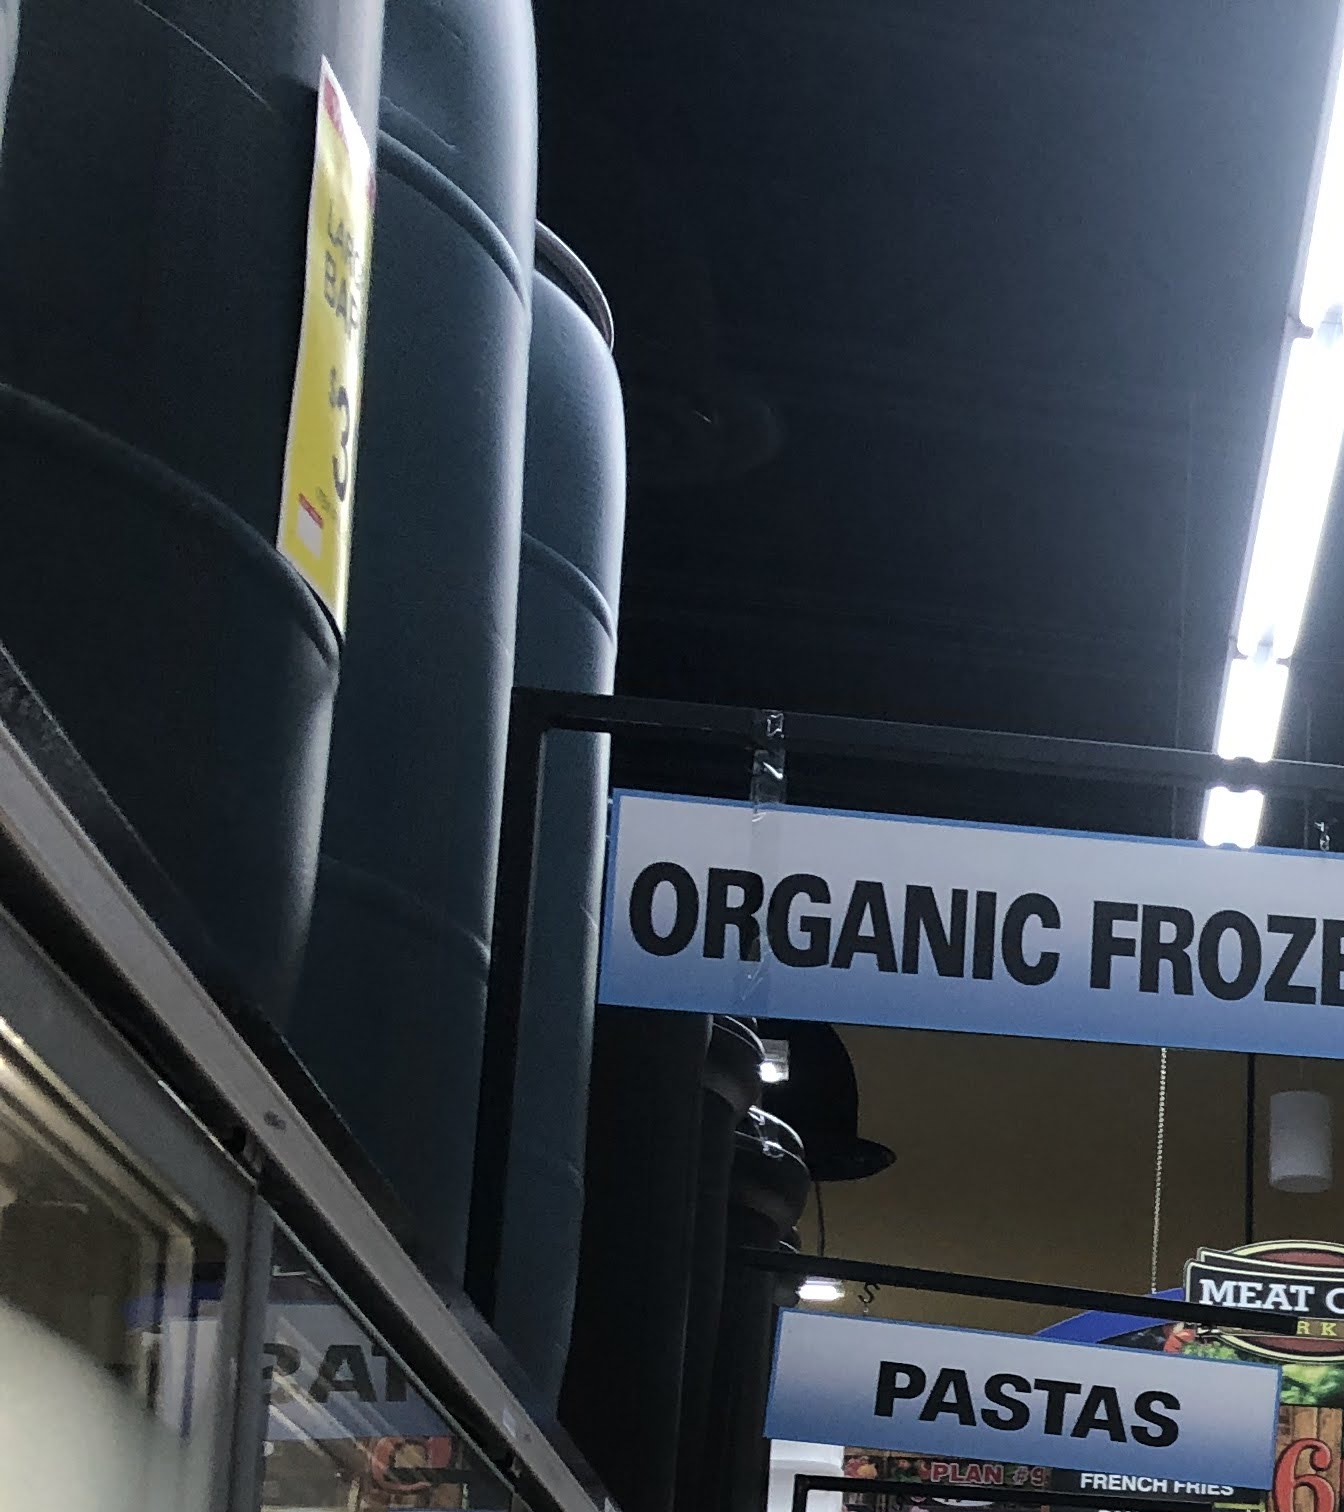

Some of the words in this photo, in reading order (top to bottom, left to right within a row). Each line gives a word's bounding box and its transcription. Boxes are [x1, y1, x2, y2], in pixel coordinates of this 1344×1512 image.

[629, 861, 1061, 986] ORGANIC
[1200, 1279, 1315, 1312] MEAT
[874, 1361, 1181, 1447] PASTAS
[932, 1462, 1002, 1485] PLAN
[1081, 1473, 1168, 1494] FRENCH
